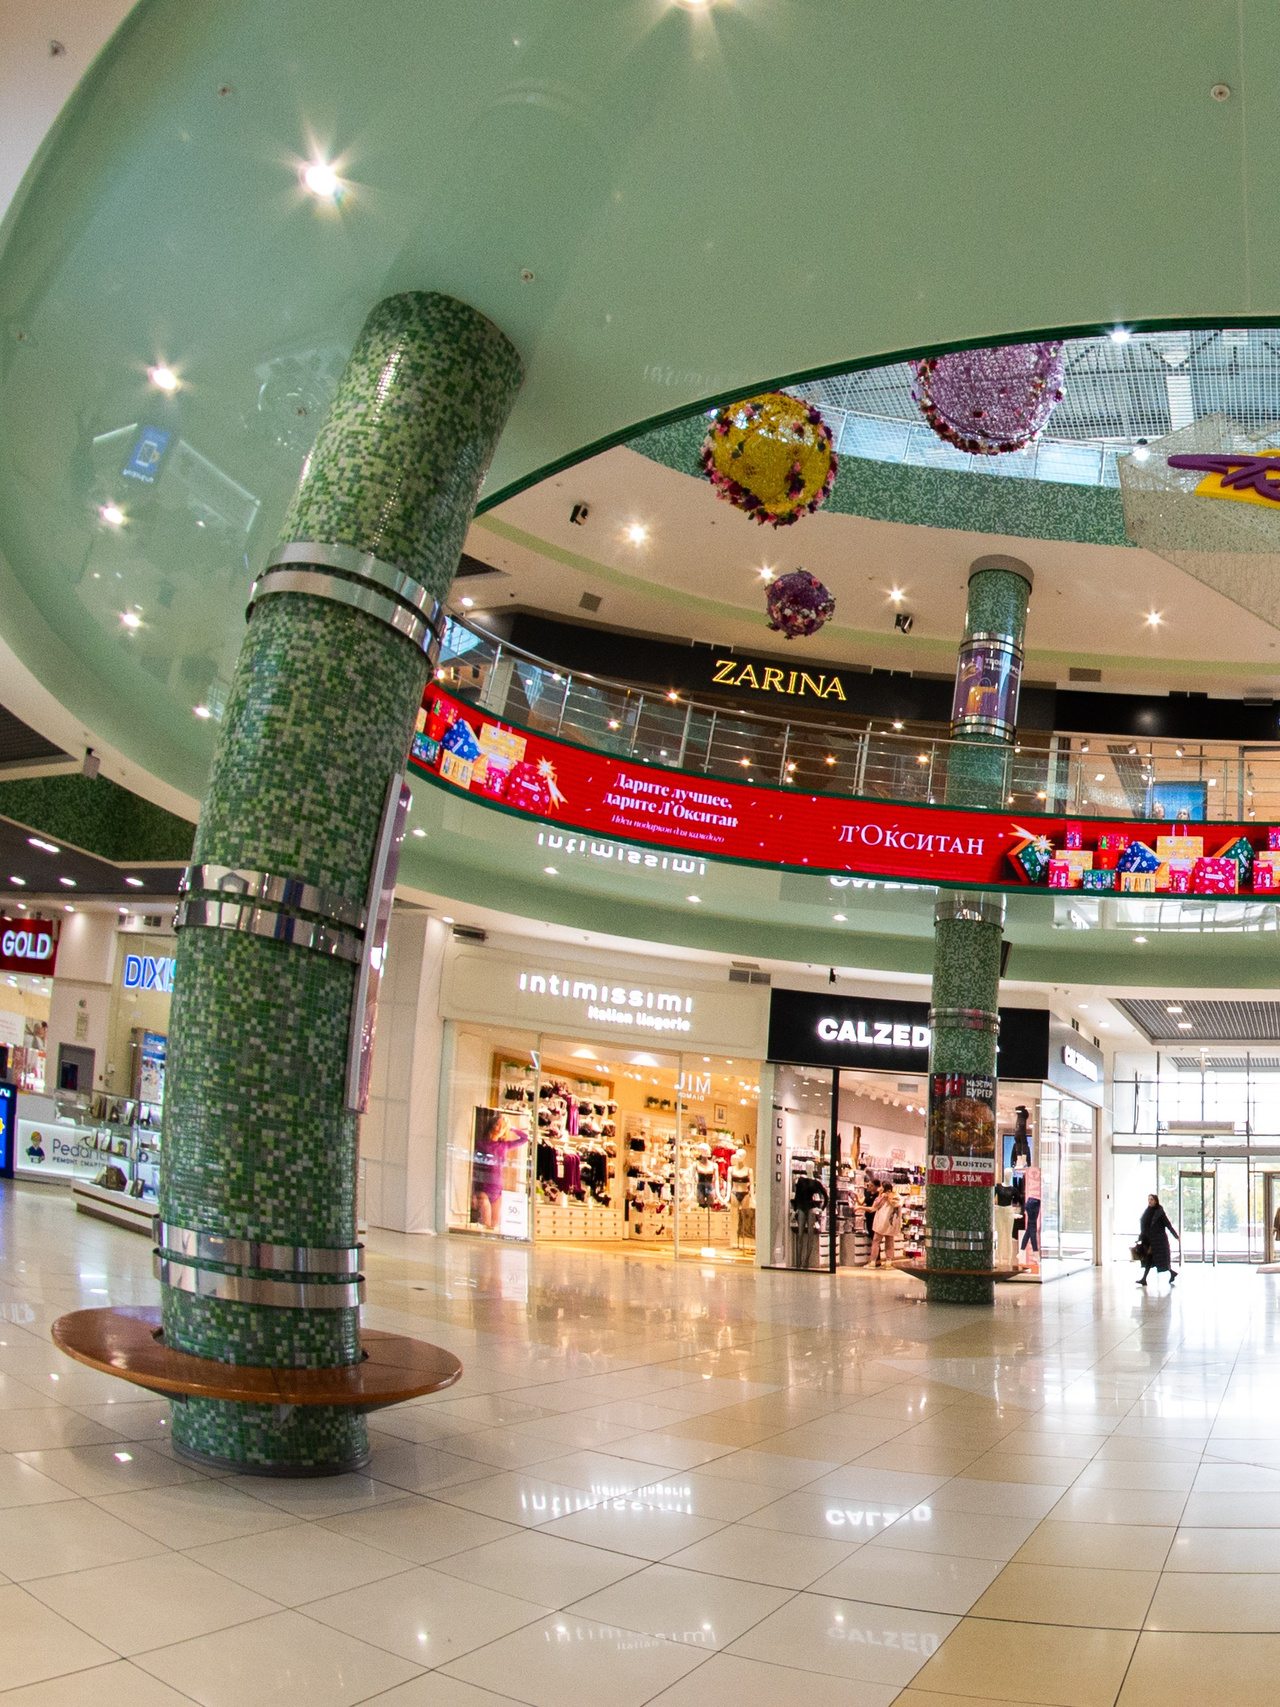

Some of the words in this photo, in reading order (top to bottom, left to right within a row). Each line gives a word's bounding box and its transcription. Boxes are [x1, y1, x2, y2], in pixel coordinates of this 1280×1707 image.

[712, 660, 847, 700] ZARINA
[602, 792, 657, 813] дарите
[613, 773, 670, 797] Дарите
[671, 788, 733, 810] лучшее,
[1, 930, 53, 960] GOLD
[816, 1018, 932, 1048] CALZED
[966, 1087, 993, 1099] БУРГЕР
[962, 1174, 982, 1183] ЭТАЖ
